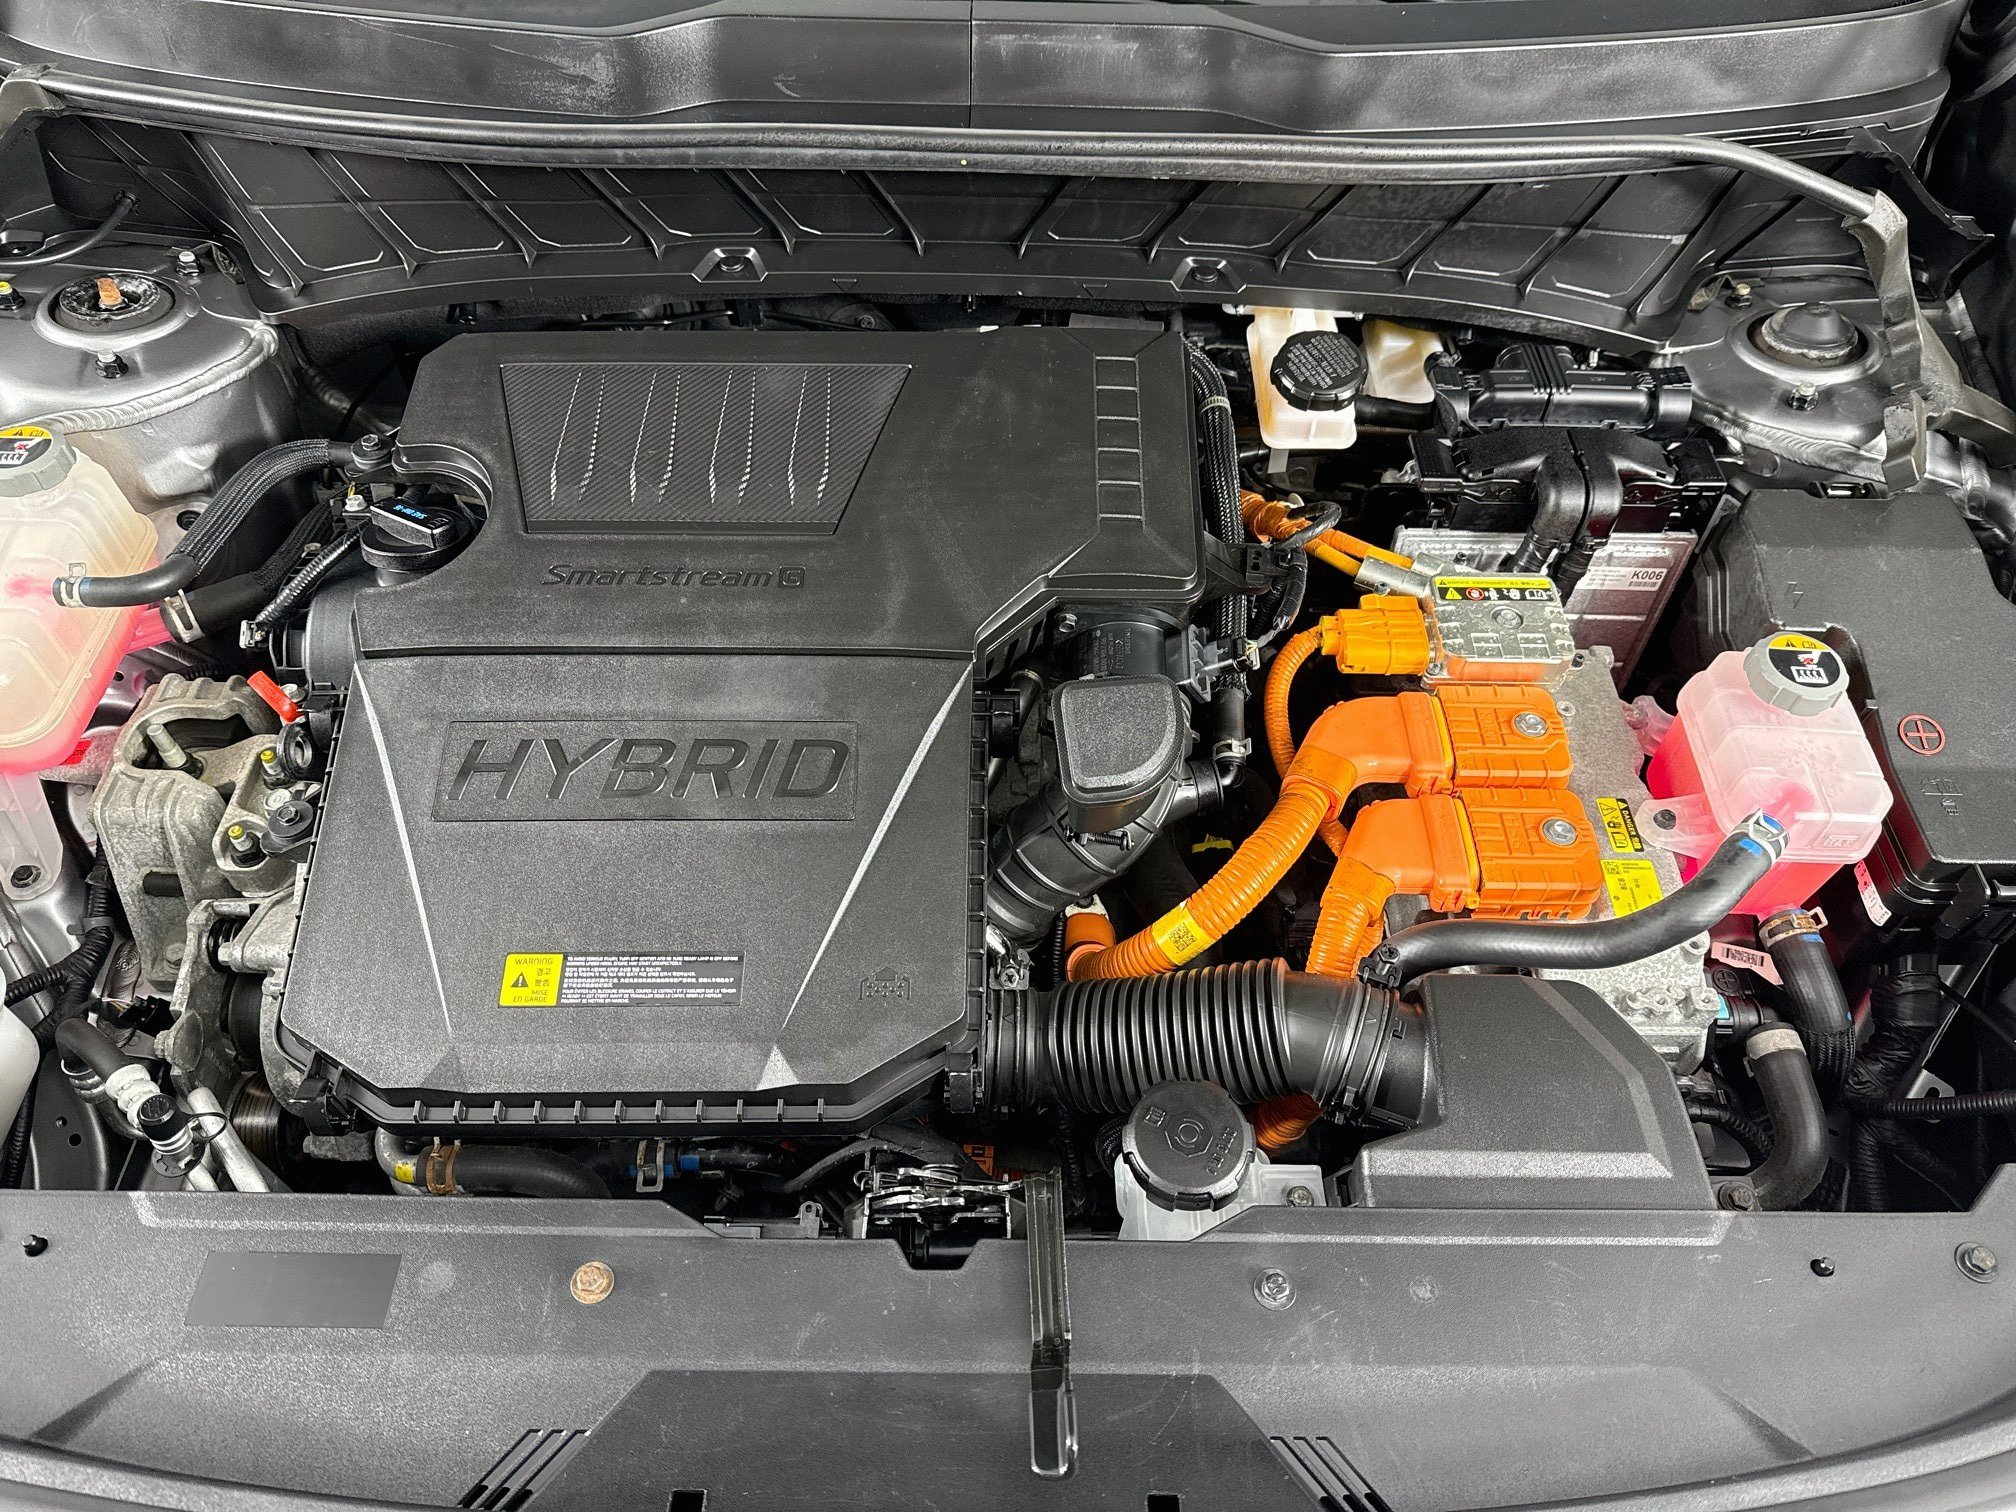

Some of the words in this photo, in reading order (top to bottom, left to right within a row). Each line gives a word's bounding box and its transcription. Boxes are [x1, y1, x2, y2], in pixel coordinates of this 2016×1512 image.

[541, 563, 773, 588] Smartstream
[779, 566, 805, 589] G
[1631, 570, 1664, 580] K006
[447, 737, 854, 801] HYBRID
[1622, 810, 1636, 837] DANGER
[536, 968, 552, 976] 경고
